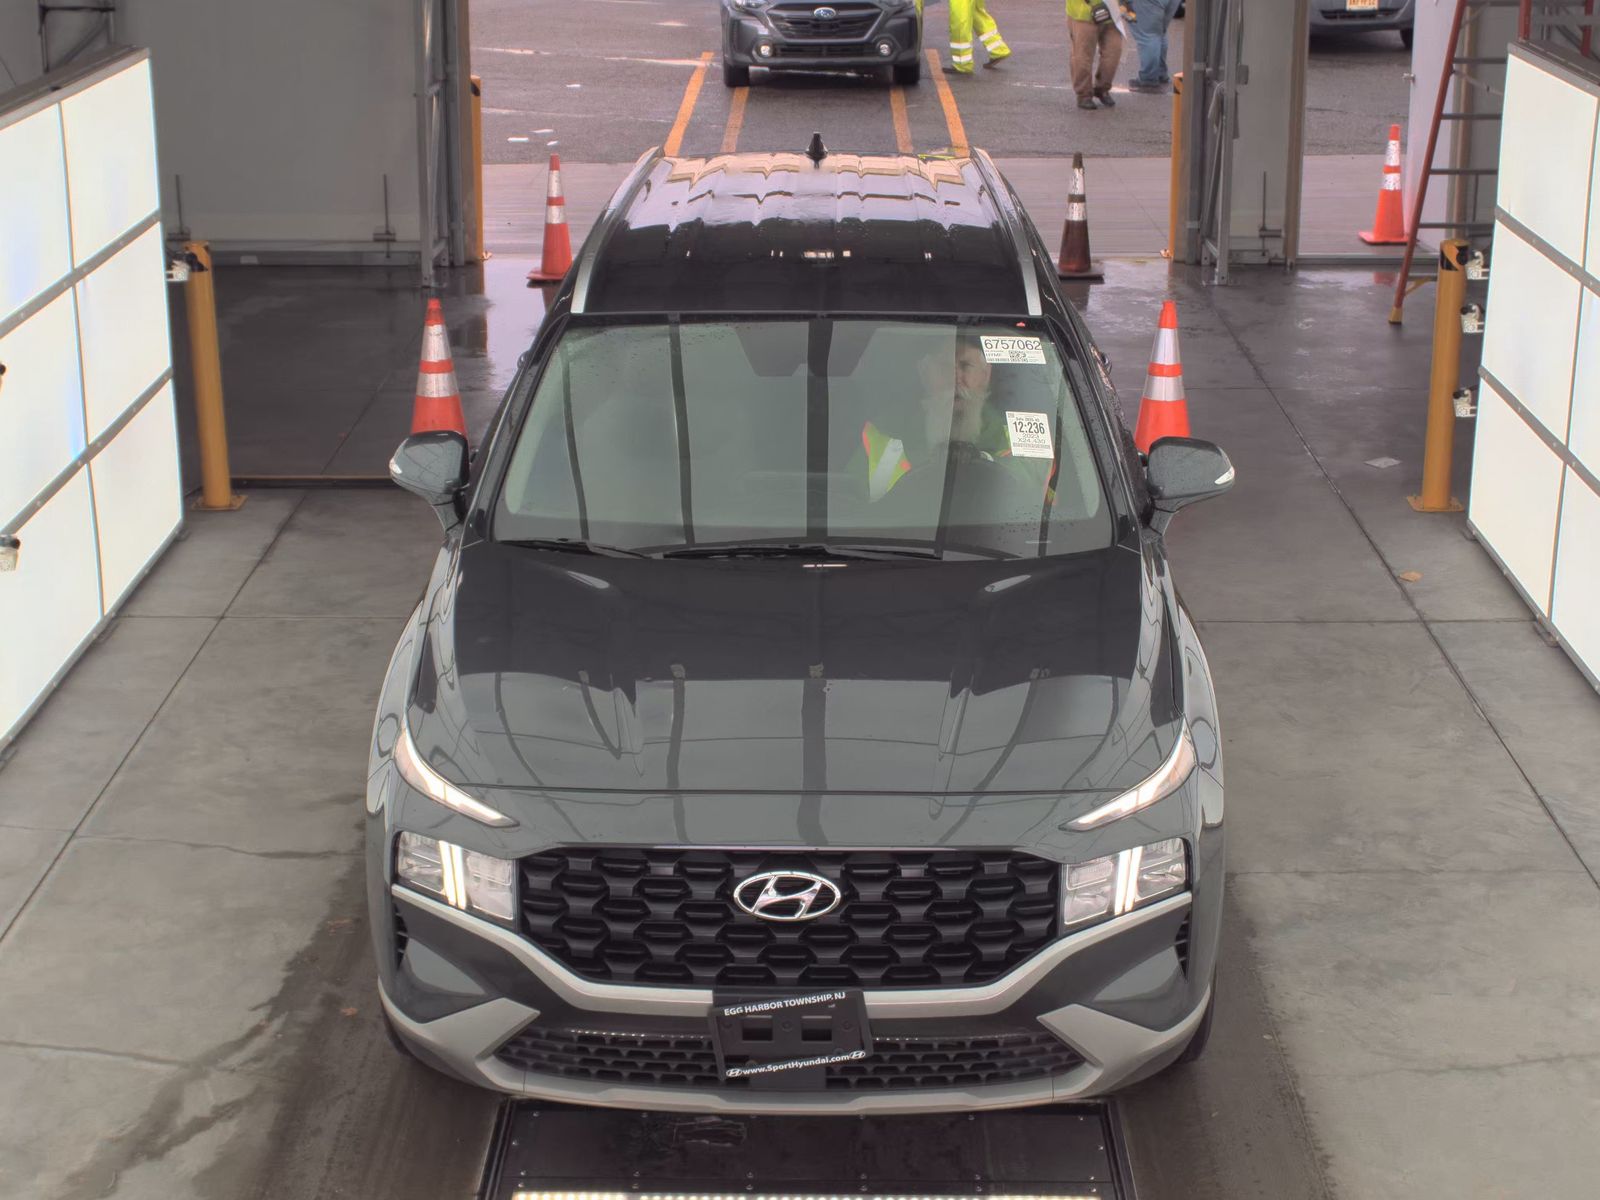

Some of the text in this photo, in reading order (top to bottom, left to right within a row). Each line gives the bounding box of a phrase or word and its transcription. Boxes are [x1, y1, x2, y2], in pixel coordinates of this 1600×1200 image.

[984, 339, 1043, 351] 6757062
[1013, 421, 1045, 434] 12:236
[724, 1007, 743, 1017] EGG
[744, 1001, 783, 1013] HARBOR
[834, 991, 846, 1001] NJ
[742, 1054, 850, 1075] www.SportHyundai.com
